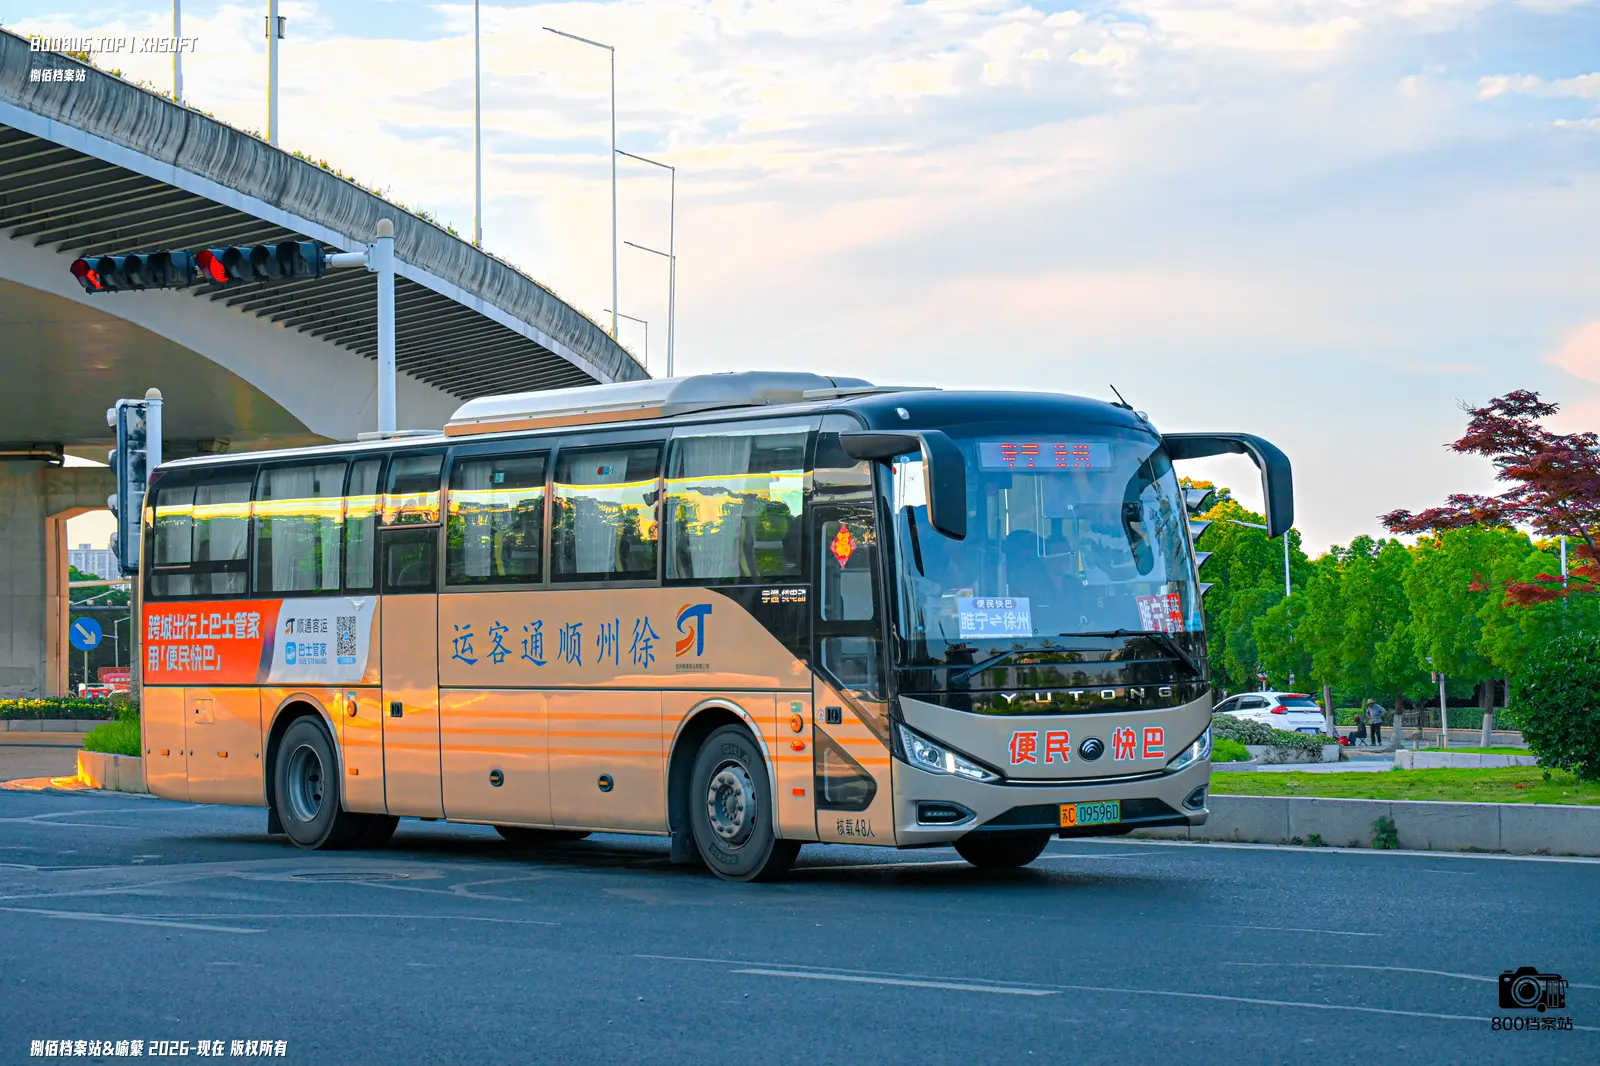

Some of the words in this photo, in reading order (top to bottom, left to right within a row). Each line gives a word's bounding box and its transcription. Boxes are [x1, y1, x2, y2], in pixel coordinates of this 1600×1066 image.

[976, 599, 1013, 609] 便民快巴
[148, 611, 260, 640] 跨城出行上巴士管家
[297, 618, 328, 634] 顺通客运
[1003, 611, 1029, 631] 徐州
[299, 642, 328, 657] 巴士管家
[1001, 686, 1172, 705] YUTONG
[1009, 730, 1071, 765] 便民
[1112, 726, 1165, 762] 快巴
[836, 817, 875, 837] 核载48人
